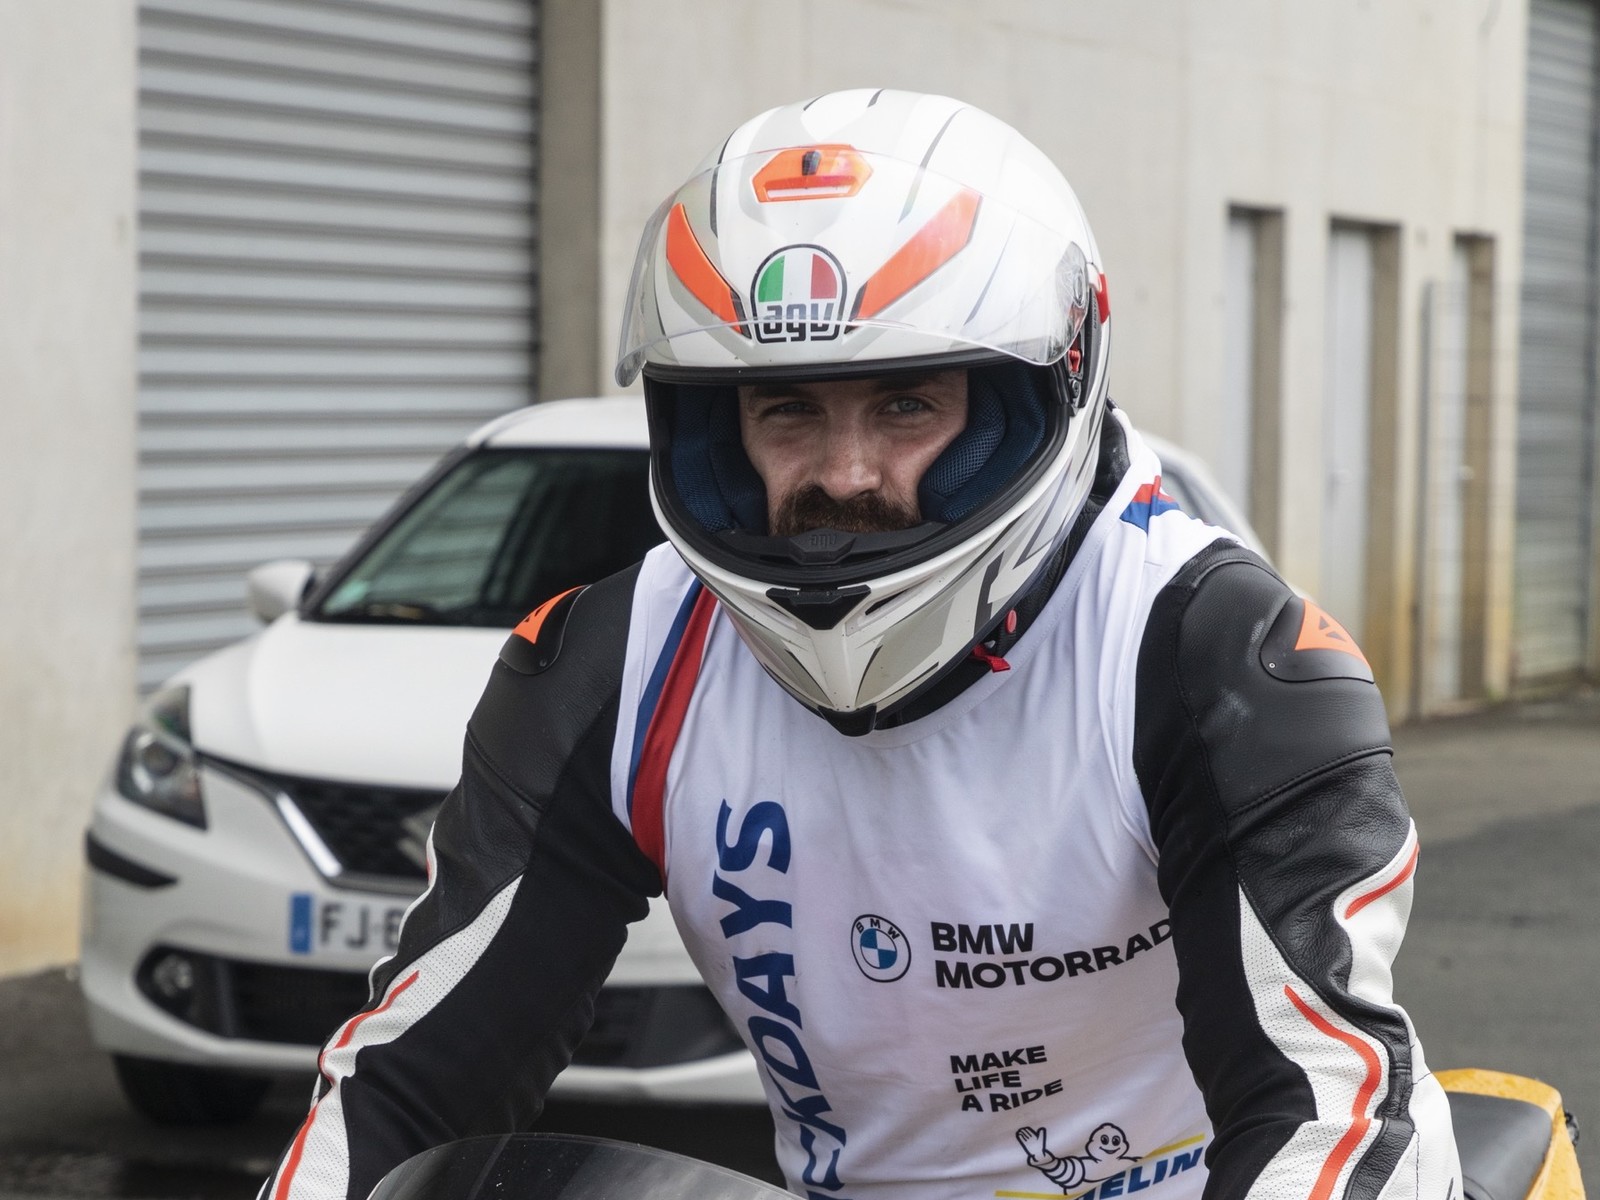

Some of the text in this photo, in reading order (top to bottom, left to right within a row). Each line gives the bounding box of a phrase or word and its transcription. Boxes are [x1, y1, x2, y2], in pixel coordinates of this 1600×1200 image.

[763, 302, 835, 341] agv
[855, 918, 901, 940] BMW
[930, 921, 1034, 955] BMW
[934, 918, 1174, 989] MOTORRAD
[950, 1045, 1047, 1074] MAKE
[954, 1070, 1022, 1093] LIFE
[961, 1079, 1063, 1112] A RIDE
